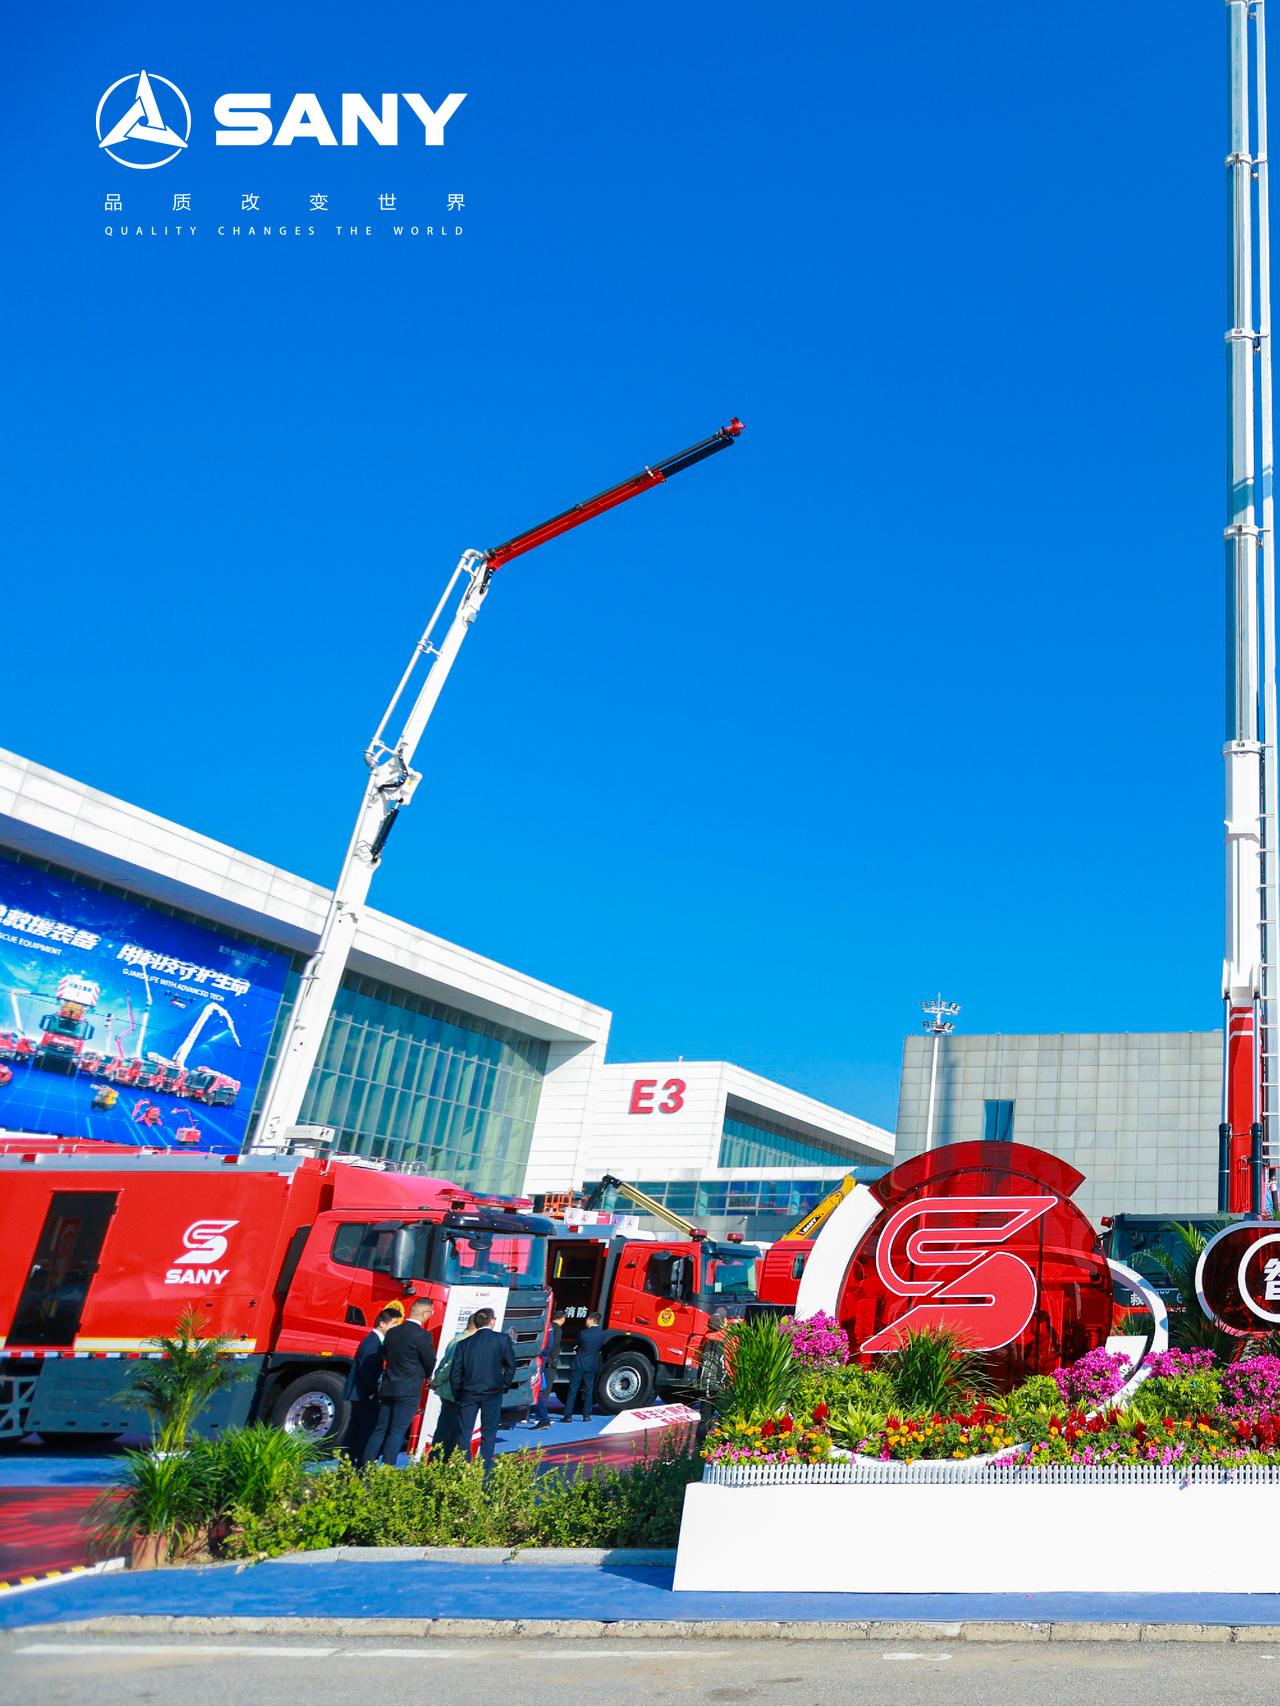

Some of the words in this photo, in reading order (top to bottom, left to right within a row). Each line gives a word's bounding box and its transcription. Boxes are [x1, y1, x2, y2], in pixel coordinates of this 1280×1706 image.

[18, 937, 62, 956] EQUIPMENT
[160, 978, 177, 989] WITH
[177, 982, 209, 998] ADVANCED
[209, 992, 225, 1002] TECH
[629, 1078, 687, 1114] E3
[802, 1217, 817, 1233] SANY
[164, 1269, 230, 1285] SANY
[565, 1306, 588, 1319] 消防
